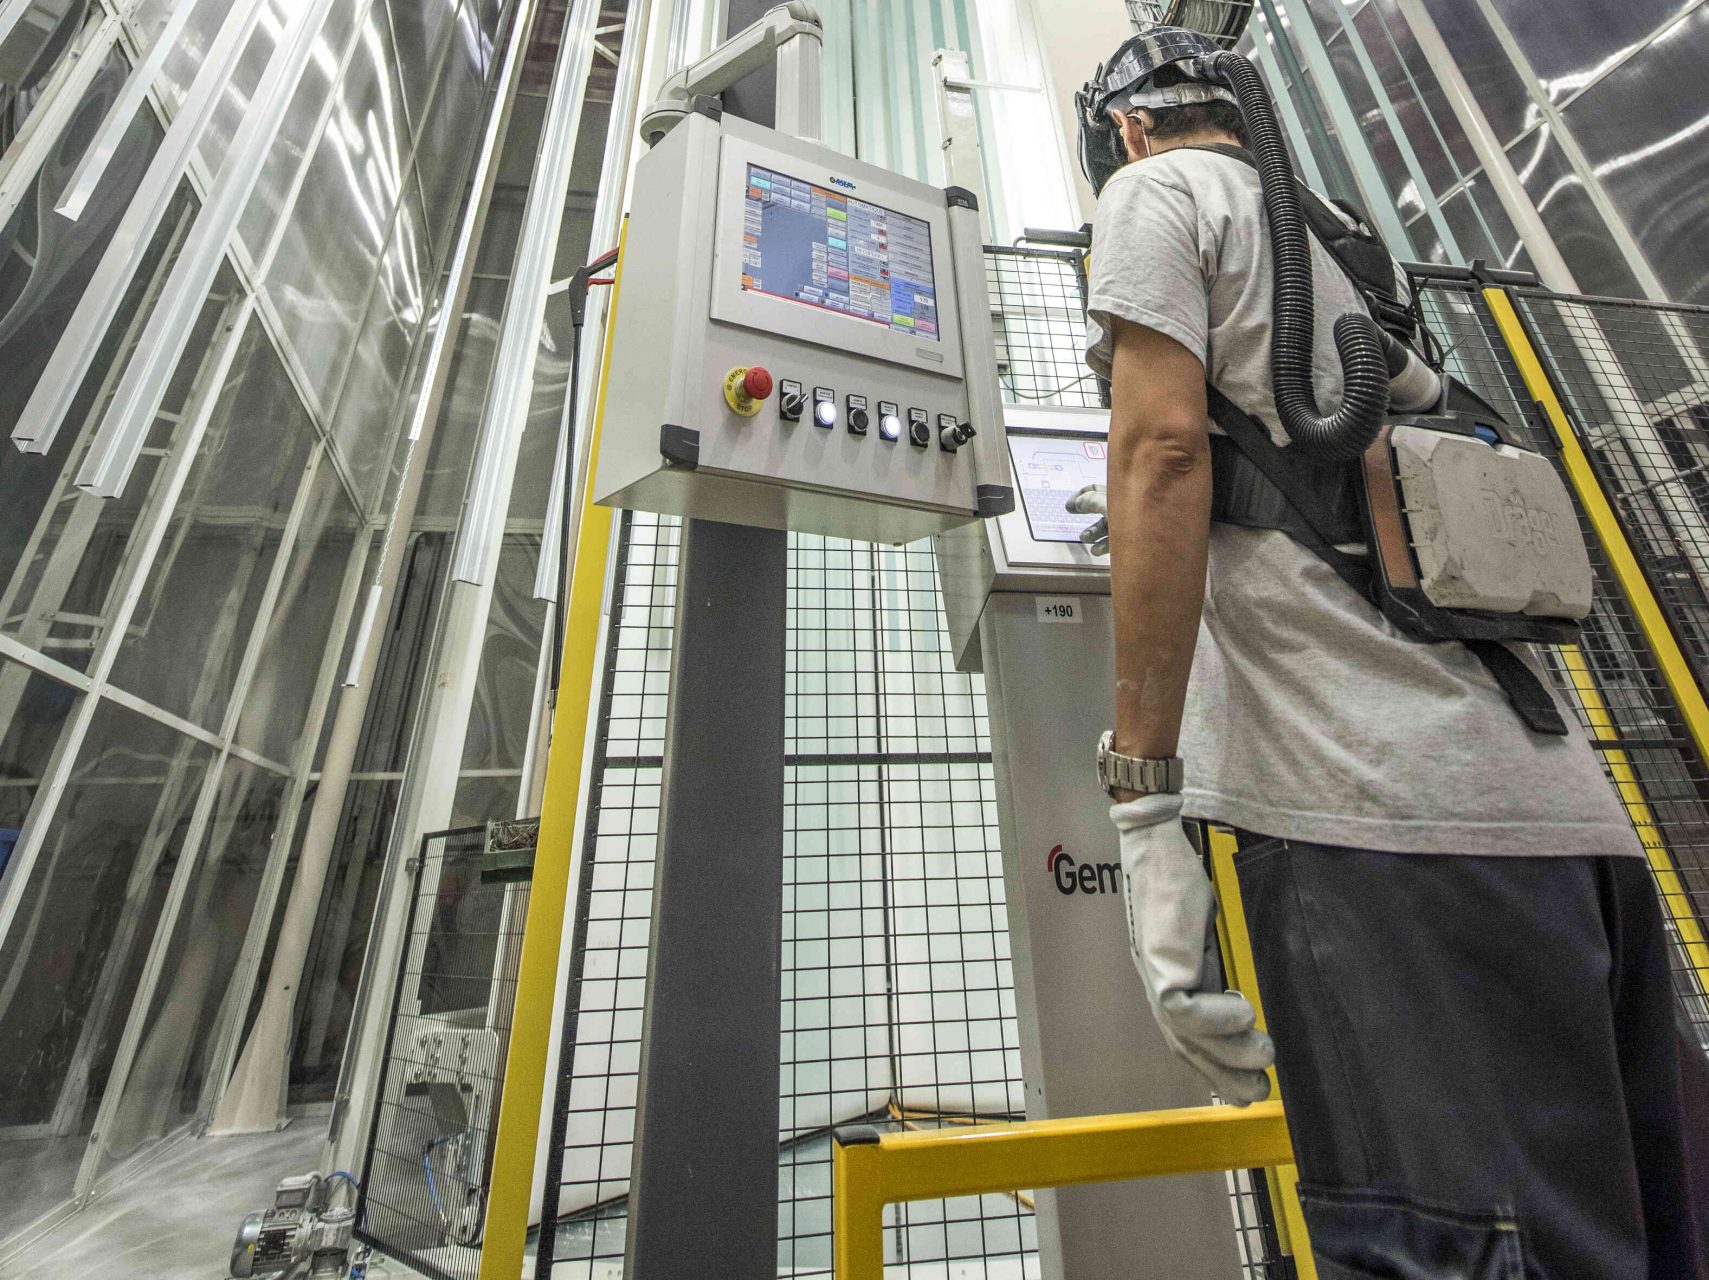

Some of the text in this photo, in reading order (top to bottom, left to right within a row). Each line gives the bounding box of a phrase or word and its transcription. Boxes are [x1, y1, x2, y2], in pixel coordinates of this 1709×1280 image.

[728, 368, 747, 383] EMERG
[736, 403, 753, 412] STOP
[1045, 605, 1073, 617] +190
[1054, 853, 1123, 895] Gem
